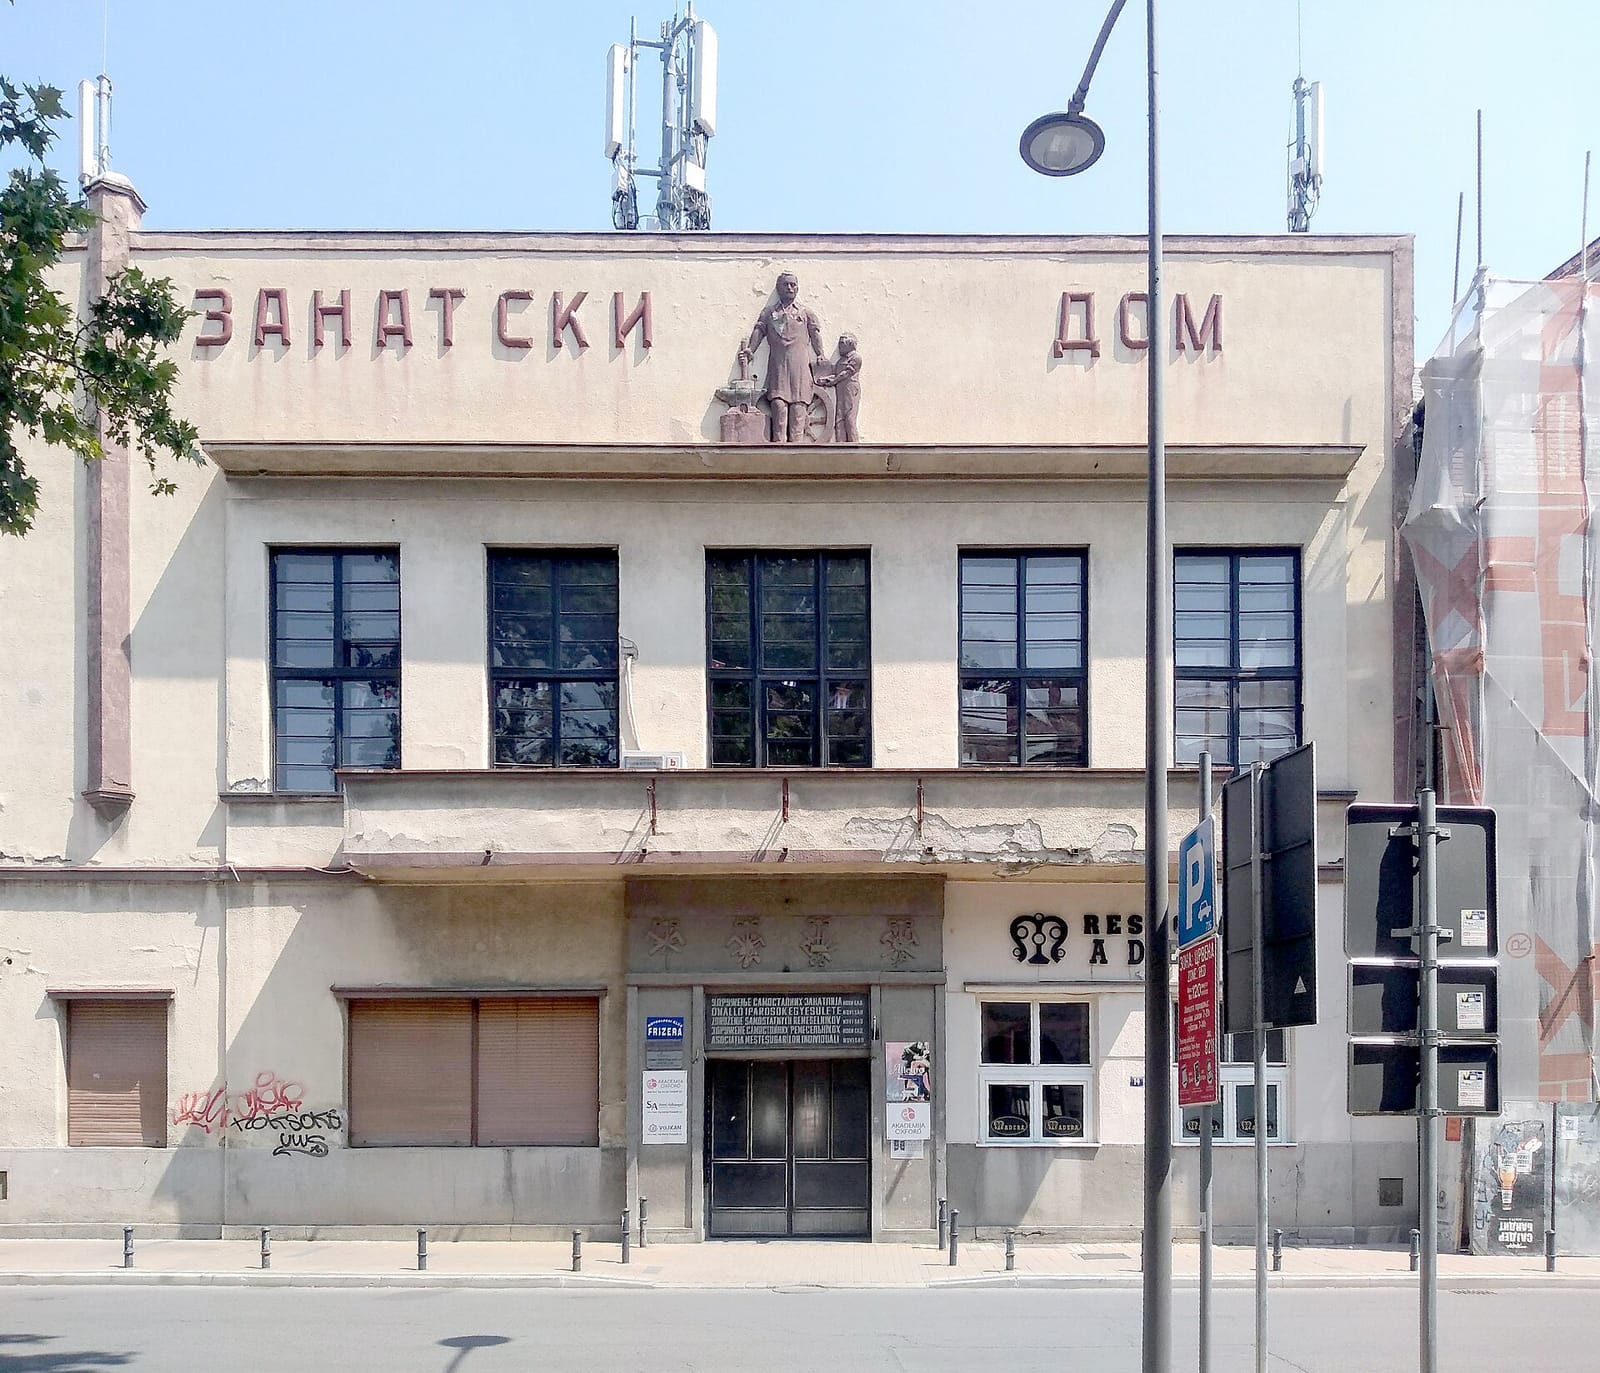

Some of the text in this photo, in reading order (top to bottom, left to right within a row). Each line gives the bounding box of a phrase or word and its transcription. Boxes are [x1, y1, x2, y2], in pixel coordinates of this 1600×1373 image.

[195, 287, 1223, 358] ЗАНАТСКИ ДОМ
[1186, 842, 1205, 930] P
[647, 1027, 683, 1036] FRIZERA
